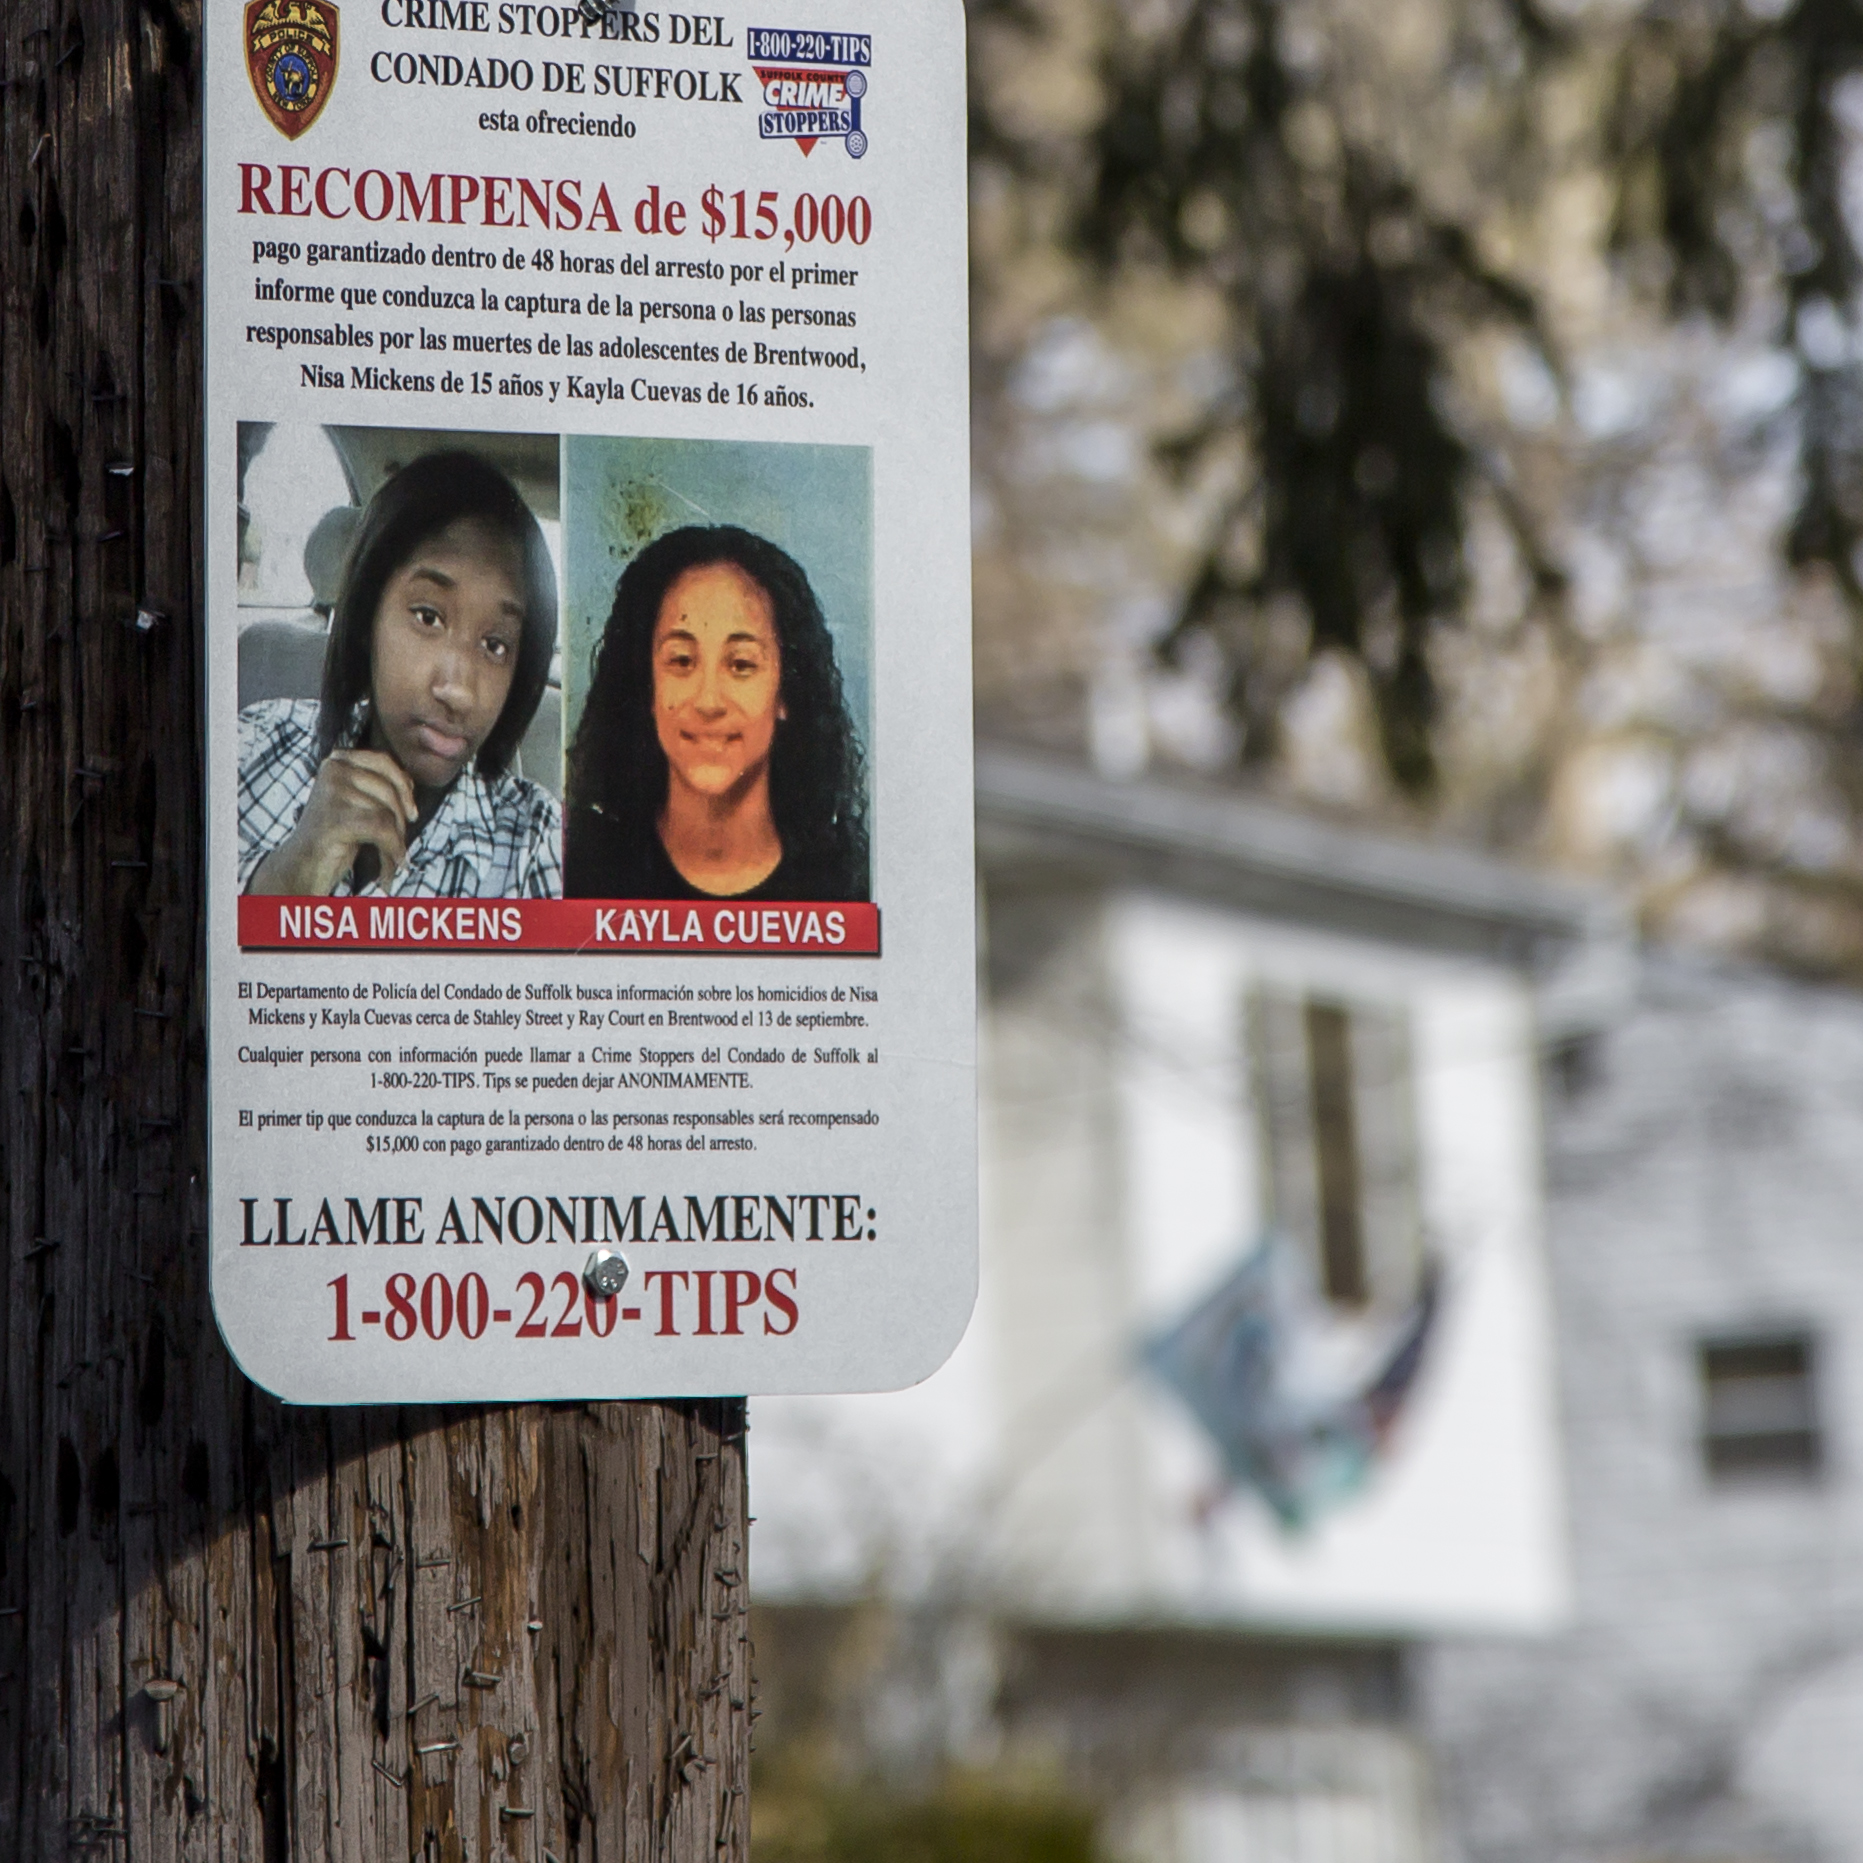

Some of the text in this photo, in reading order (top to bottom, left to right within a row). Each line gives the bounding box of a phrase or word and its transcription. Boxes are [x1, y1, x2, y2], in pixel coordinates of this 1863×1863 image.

[499, 3, 659, 43] STOPERS
[669, 14, 733, 47] DEL
[749, 31, 870, 63] 1-800-220-TIPS
[371, 51, 743, 103] CONDADO DE SUFFOLK
[764, 79, 852, 109] CRIME
[479, 110, 636, 138] esta ofreciendo
[764, 110, 851, 134] STOPPERS
[237, 163, 871, 253] RECOMPENSA de $15,000
[253, 241, 858, 287] pago garantizado dentro de 48 horas del arresto por el primer
[246, 323, 865, 373] responsables por las muertes de las adolescentes de Brentwood,
[301, 364, 813, 407] Nisa Mickens de 15 años y Kayla Cuevas de 16 años.
[281, 906, 521, 940] NISA MICKENS
[597, 909, 845, 943] KAYLA CUEVAS
[372, 1072, 752, 1092] 1-800-220-TIPS. Tips se pueden dejar ANONIMAMENTE.
[367, 1135, 756, 1156] $15,000 con pago garantizado dentro de 48 horas del arresto.
[239, 1195, 876, 1246] LLAME ANONIMAMENTE:
[326, 1267, 800, 1341] 1-800-220-TIPS
